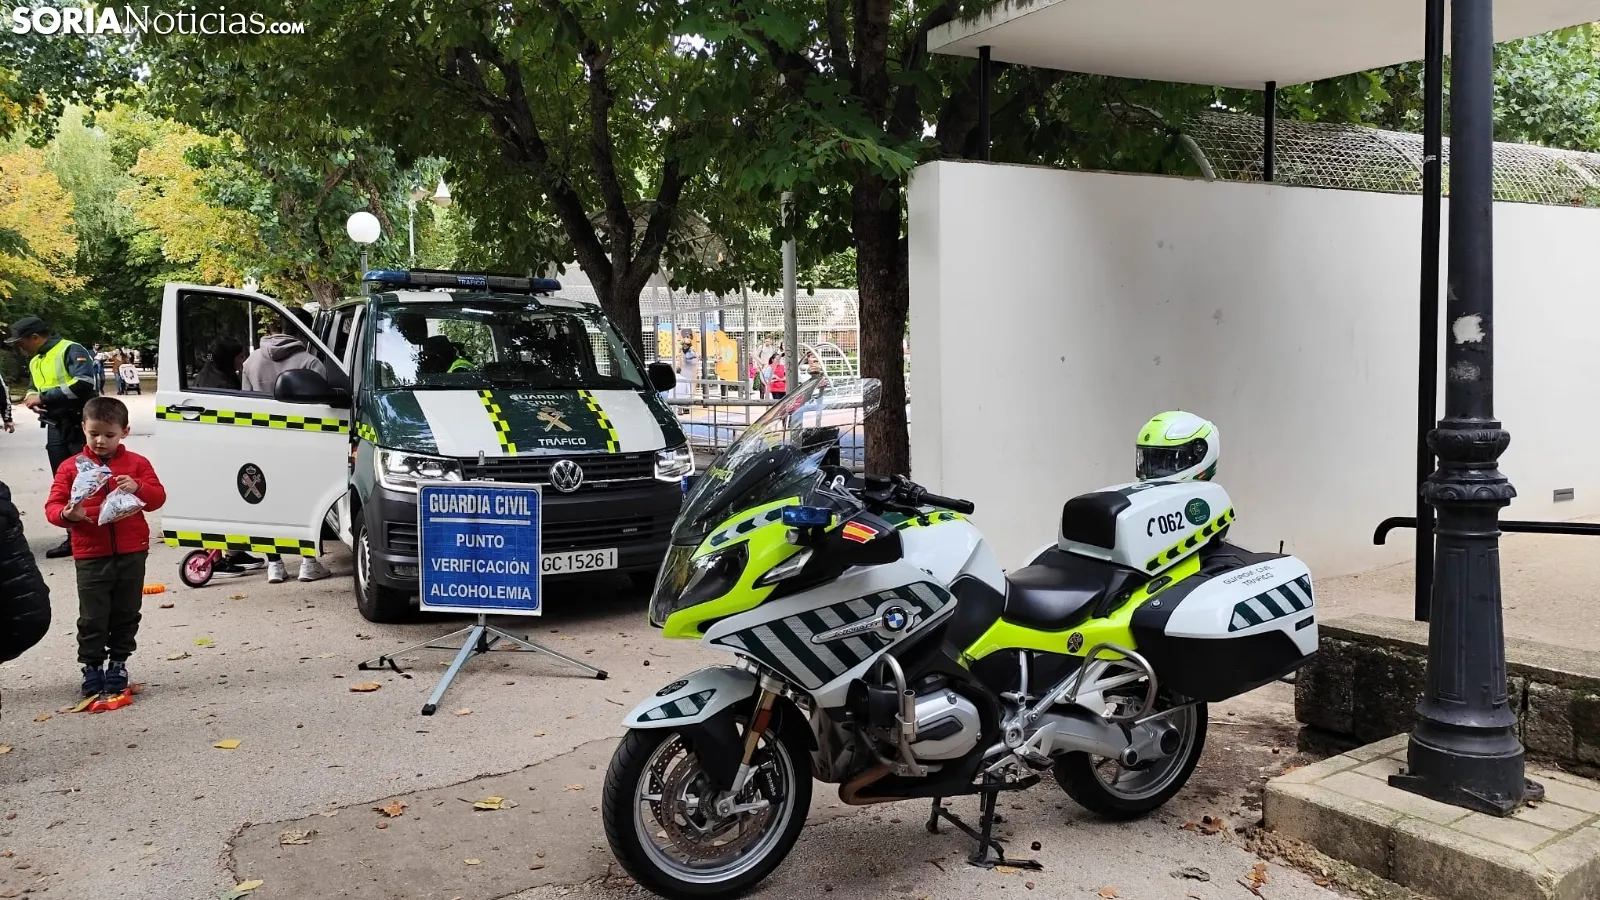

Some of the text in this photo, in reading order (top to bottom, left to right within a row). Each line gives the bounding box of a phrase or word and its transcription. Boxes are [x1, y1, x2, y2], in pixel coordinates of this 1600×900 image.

[538, 437, 587, 446] TRÁFICO
[429, 493, 531, 516] GUARDIA CIVIL
[1157, 511, 1186, 535] 062
[456, 533, 505, 549] PUNTO
[431, 557, 530, 575] VERIFICACIÓN
[567, 552, 605, 570] 1526
[430, 583, 532, 600] ALCOHOLEMIA
